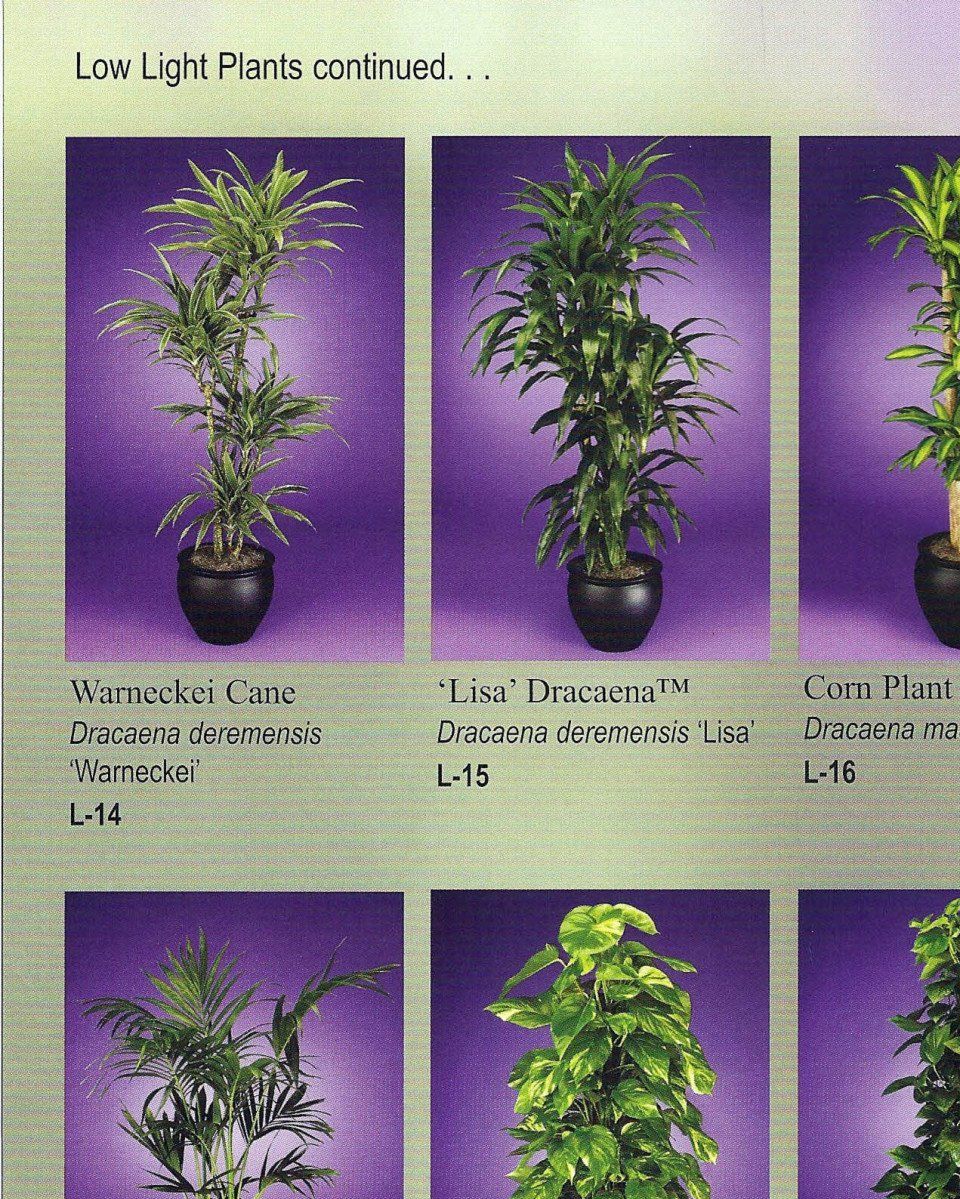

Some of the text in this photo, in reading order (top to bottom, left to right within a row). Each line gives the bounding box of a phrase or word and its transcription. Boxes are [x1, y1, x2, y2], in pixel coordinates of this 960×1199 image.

[76, 51, 132, 80] Low
[142, 51, 208, 88] Light
[218, 51, 303, 80] Plants
[70, 678, 296, 705] Warneckei Cane
[438, 677, 517, 704] ‘Lisa’
[803, 674, 952, 700] Corn Plant
[69, 720, 322, 745] Dracaena deremensis
[437, 719, 755, 744] Dracaena deremensis ‘Lisa’
[804, 716, 915, 740] Dracaena
[69, 758, 200, 784] ‘Warneckei’
[437, 763, 490, 788] L-15
[804, 759, 856, 784] L-16
[70, 802, 122, 826] L-14
